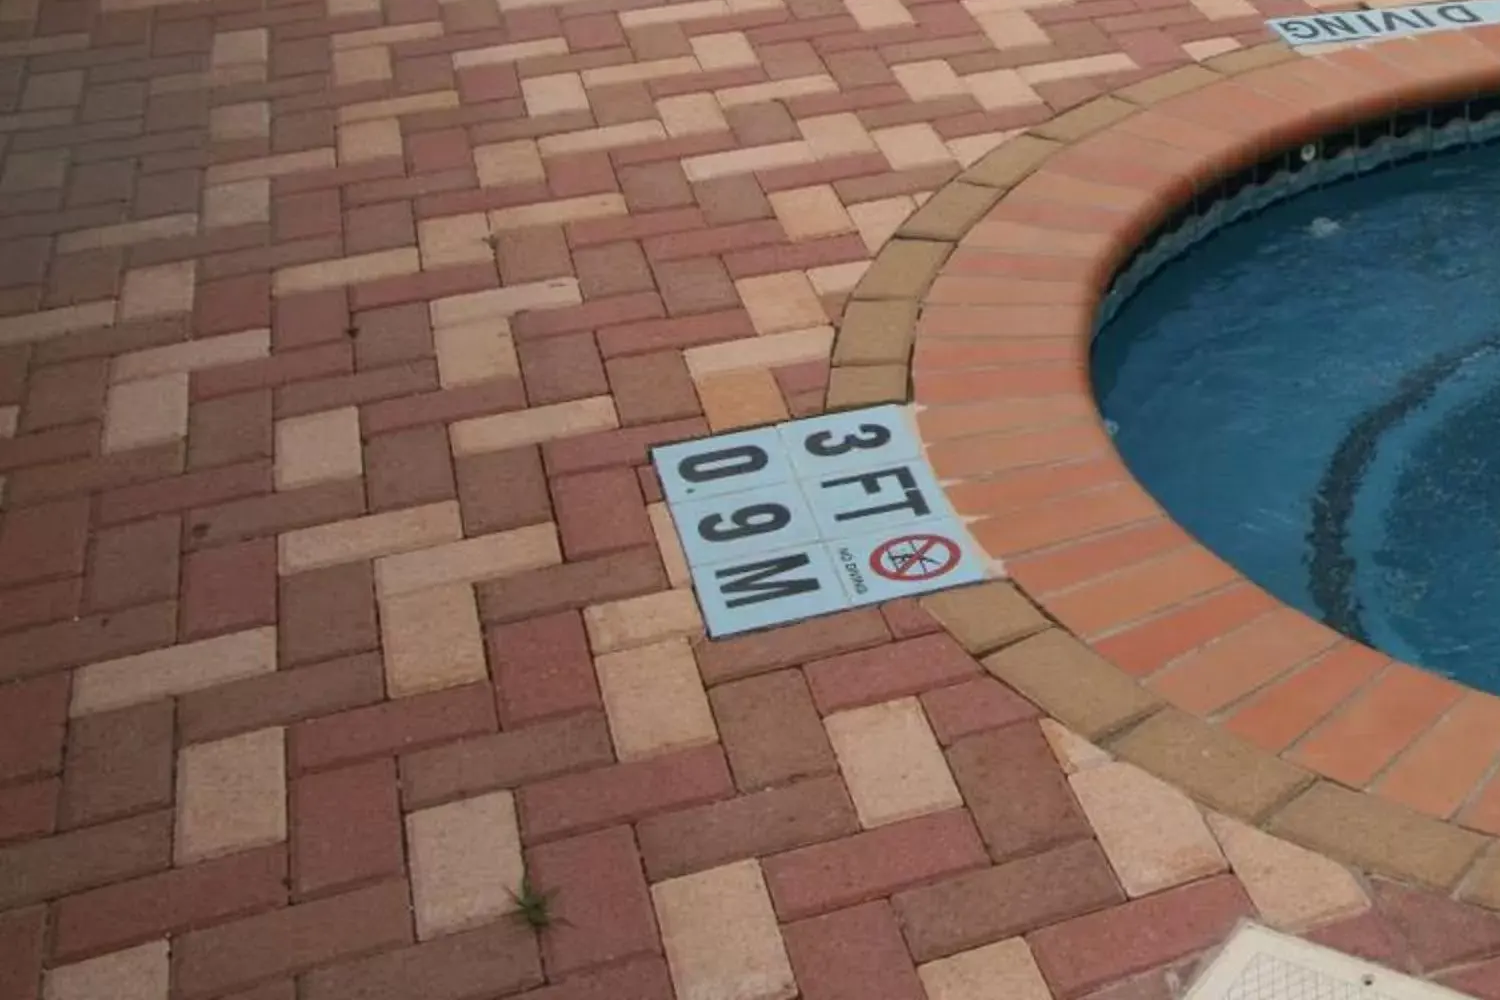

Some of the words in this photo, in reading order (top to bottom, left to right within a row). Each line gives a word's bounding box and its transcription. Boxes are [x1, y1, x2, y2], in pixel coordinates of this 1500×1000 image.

[1278, 4, 1481, 41] DIVING
[804, 422, 892, 457] 3
[820, 464, 932, 522] FT
[714, 550, 822, 610] M
